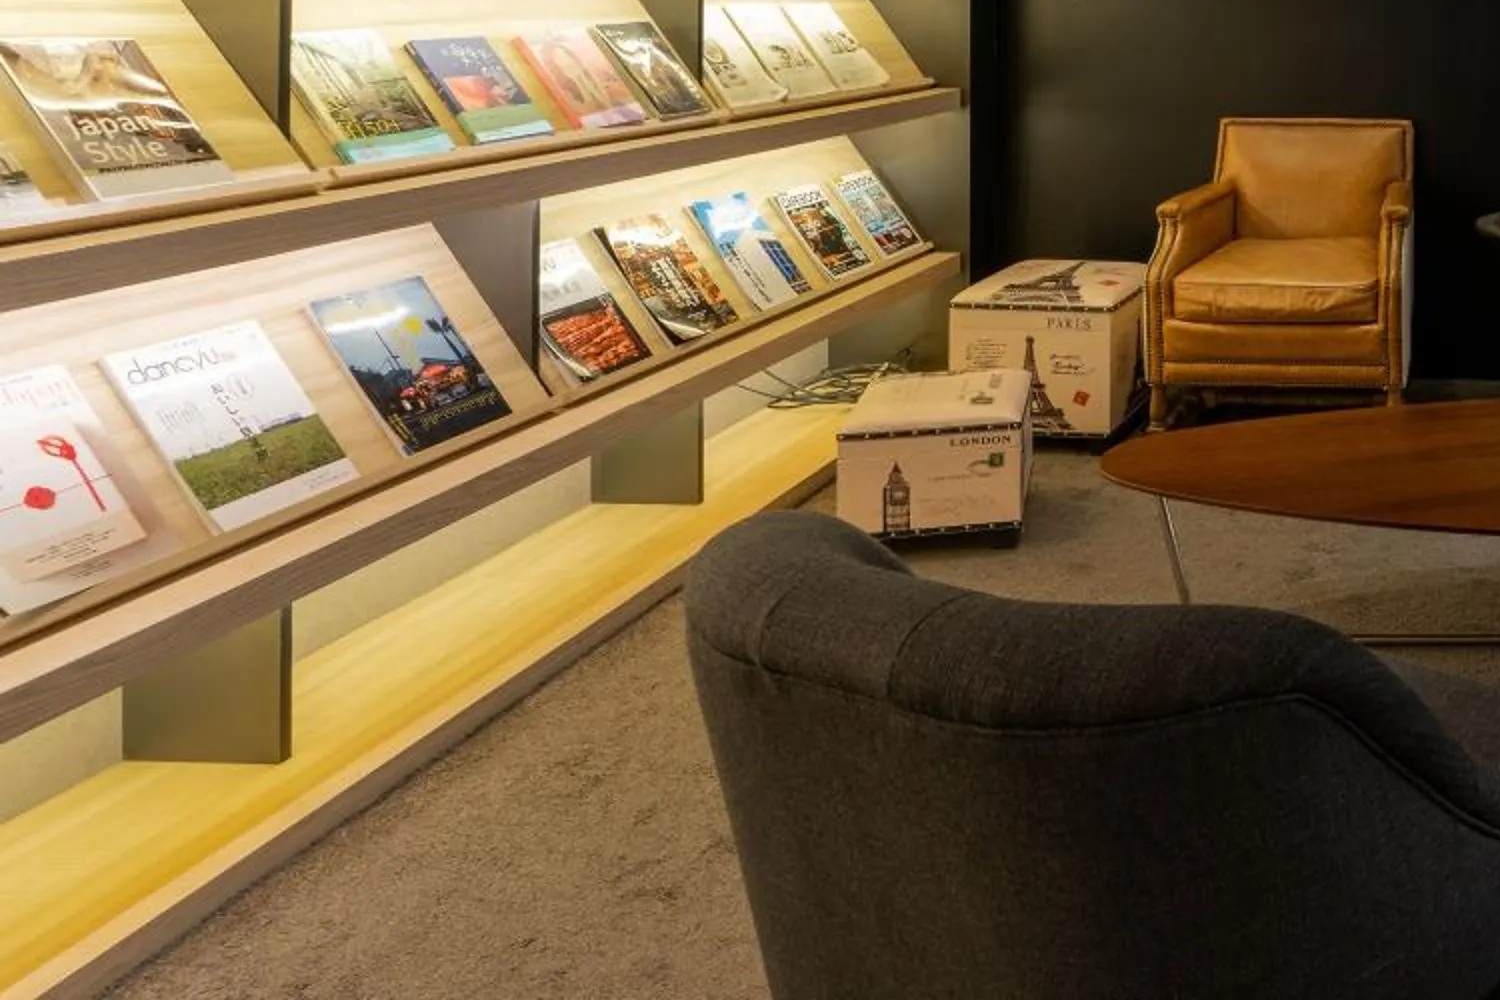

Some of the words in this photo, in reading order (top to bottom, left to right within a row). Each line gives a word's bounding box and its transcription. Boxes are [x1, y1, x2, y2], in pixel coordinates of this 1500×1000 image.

[64, 114, 157, 141] Japan
[83, 136, 168, 166] Style
[1047, 317, 1092, 331] PARIS
[949, 435, 1011, 447] LONDON
